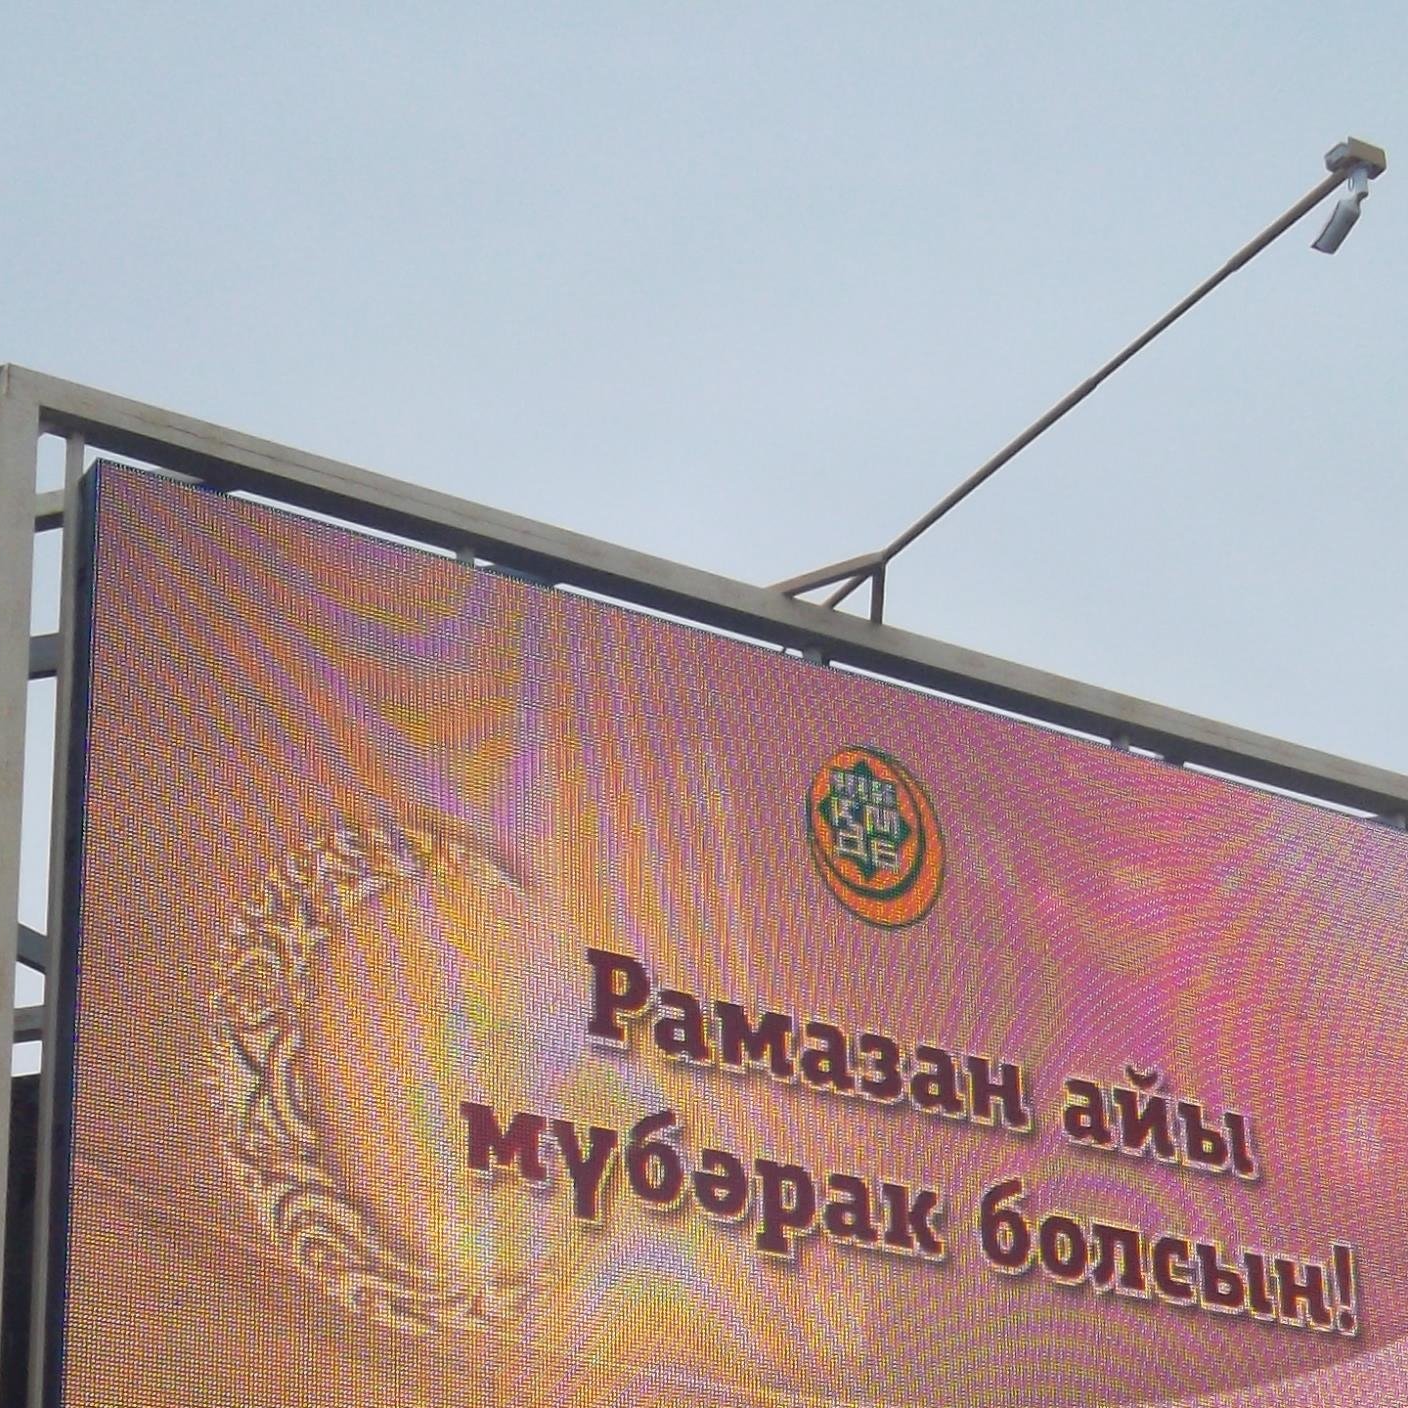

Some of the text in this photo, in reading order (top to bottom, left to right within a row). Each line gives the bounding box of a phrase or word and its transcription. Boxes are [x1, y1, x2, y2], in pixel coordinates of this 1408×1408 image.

[586, 947, 1255, 1176] Рамазан айы
[460, 1101, 1356, 1333] мүбәрак болсын!
